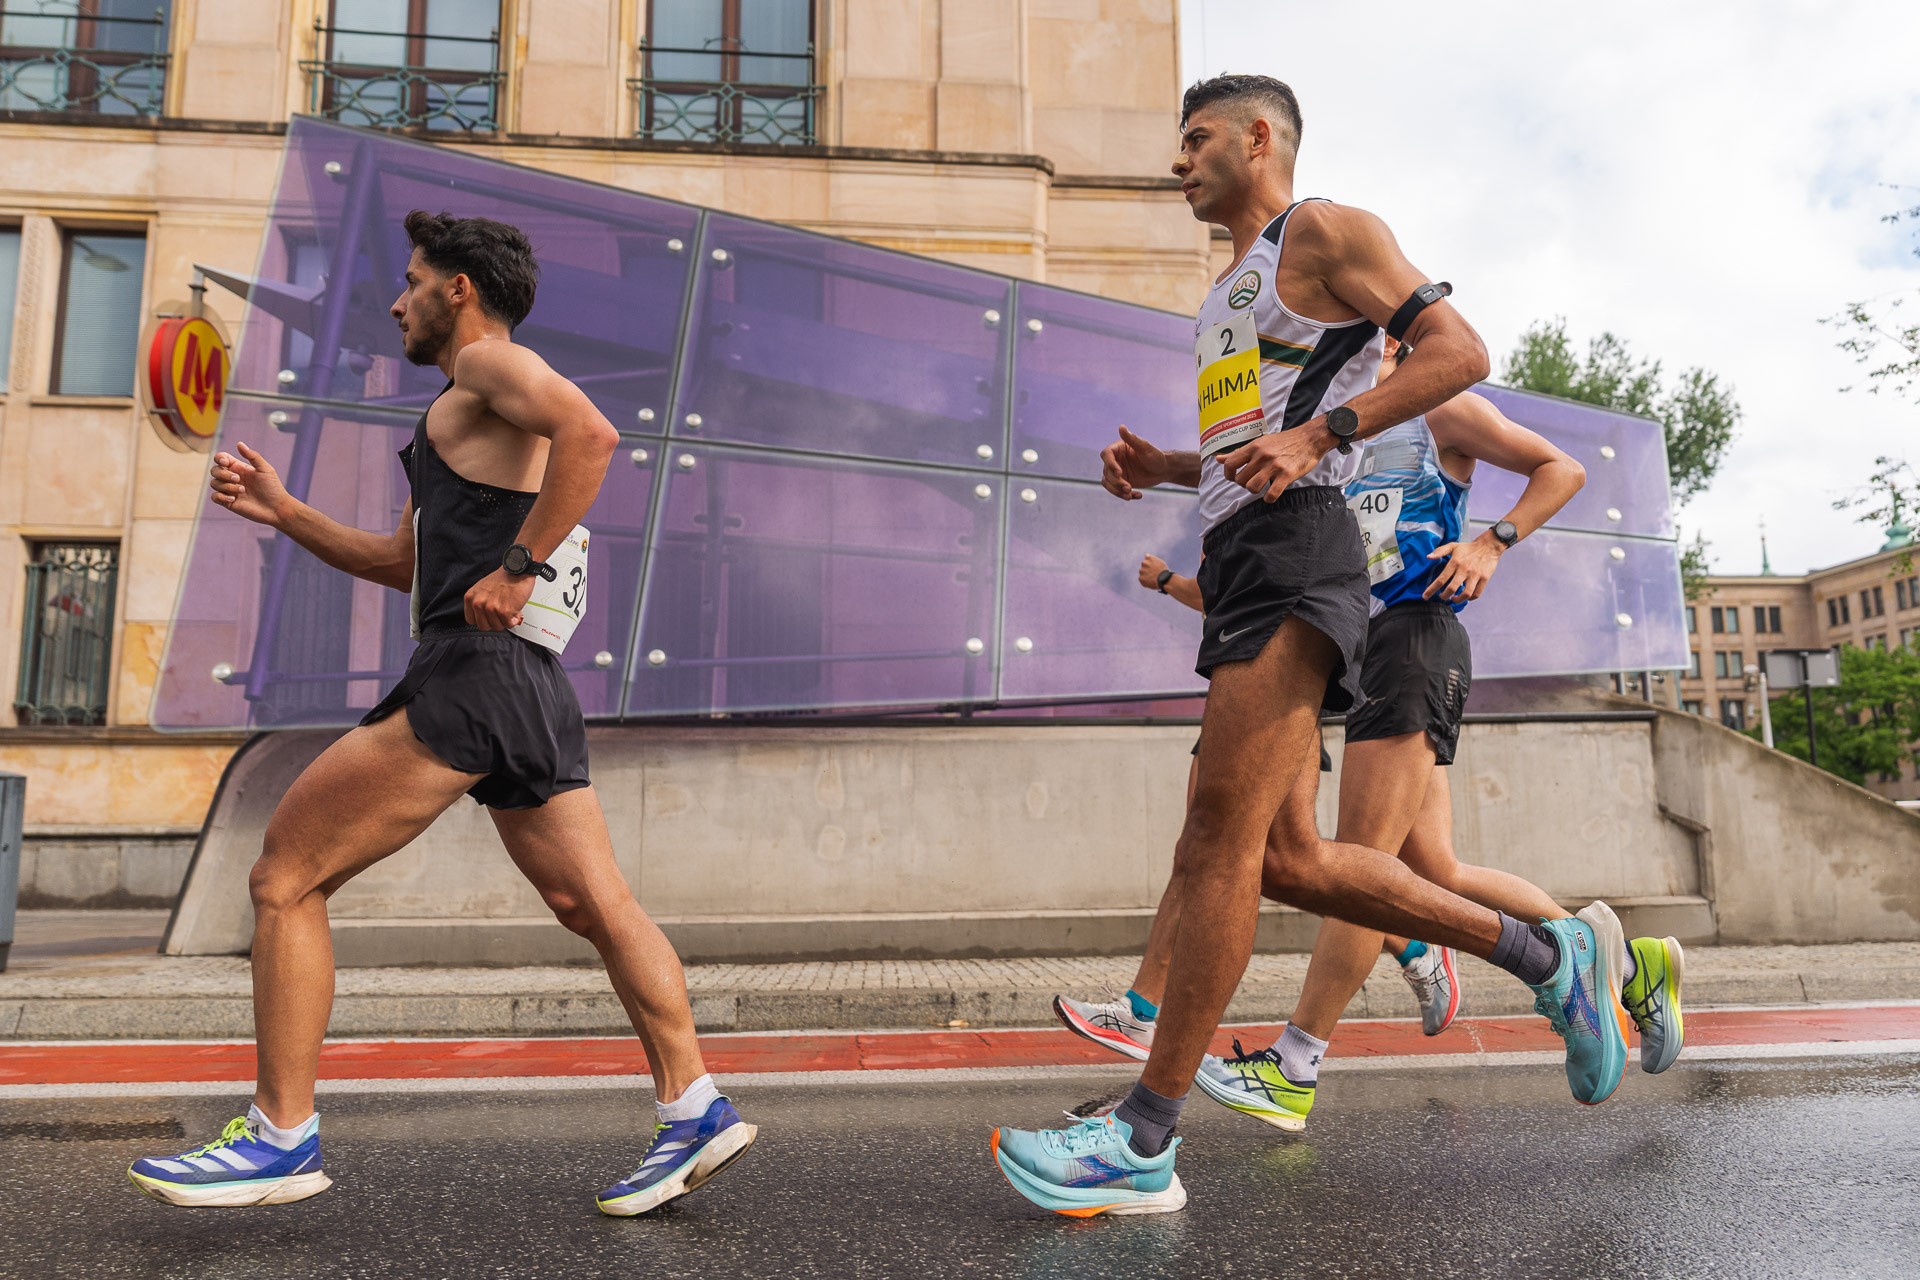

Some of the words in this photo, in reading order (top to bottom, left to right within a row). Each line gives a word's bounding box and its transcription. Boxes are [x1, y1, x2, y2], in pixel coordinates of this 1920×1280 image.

[1233, 275, 1257, 294] RKS
[1220, 328, 1236, 356] 2
[179, 332, 222, 415] M
[1203, 369, 1258, 409] HLIMA
[1219, 429, 1238, 439] WALKING
[1238, 425, 1248, 433] CUP
[1249, 421, 1263, 430] 2025
[1360, 493, 1389, 514] 40
